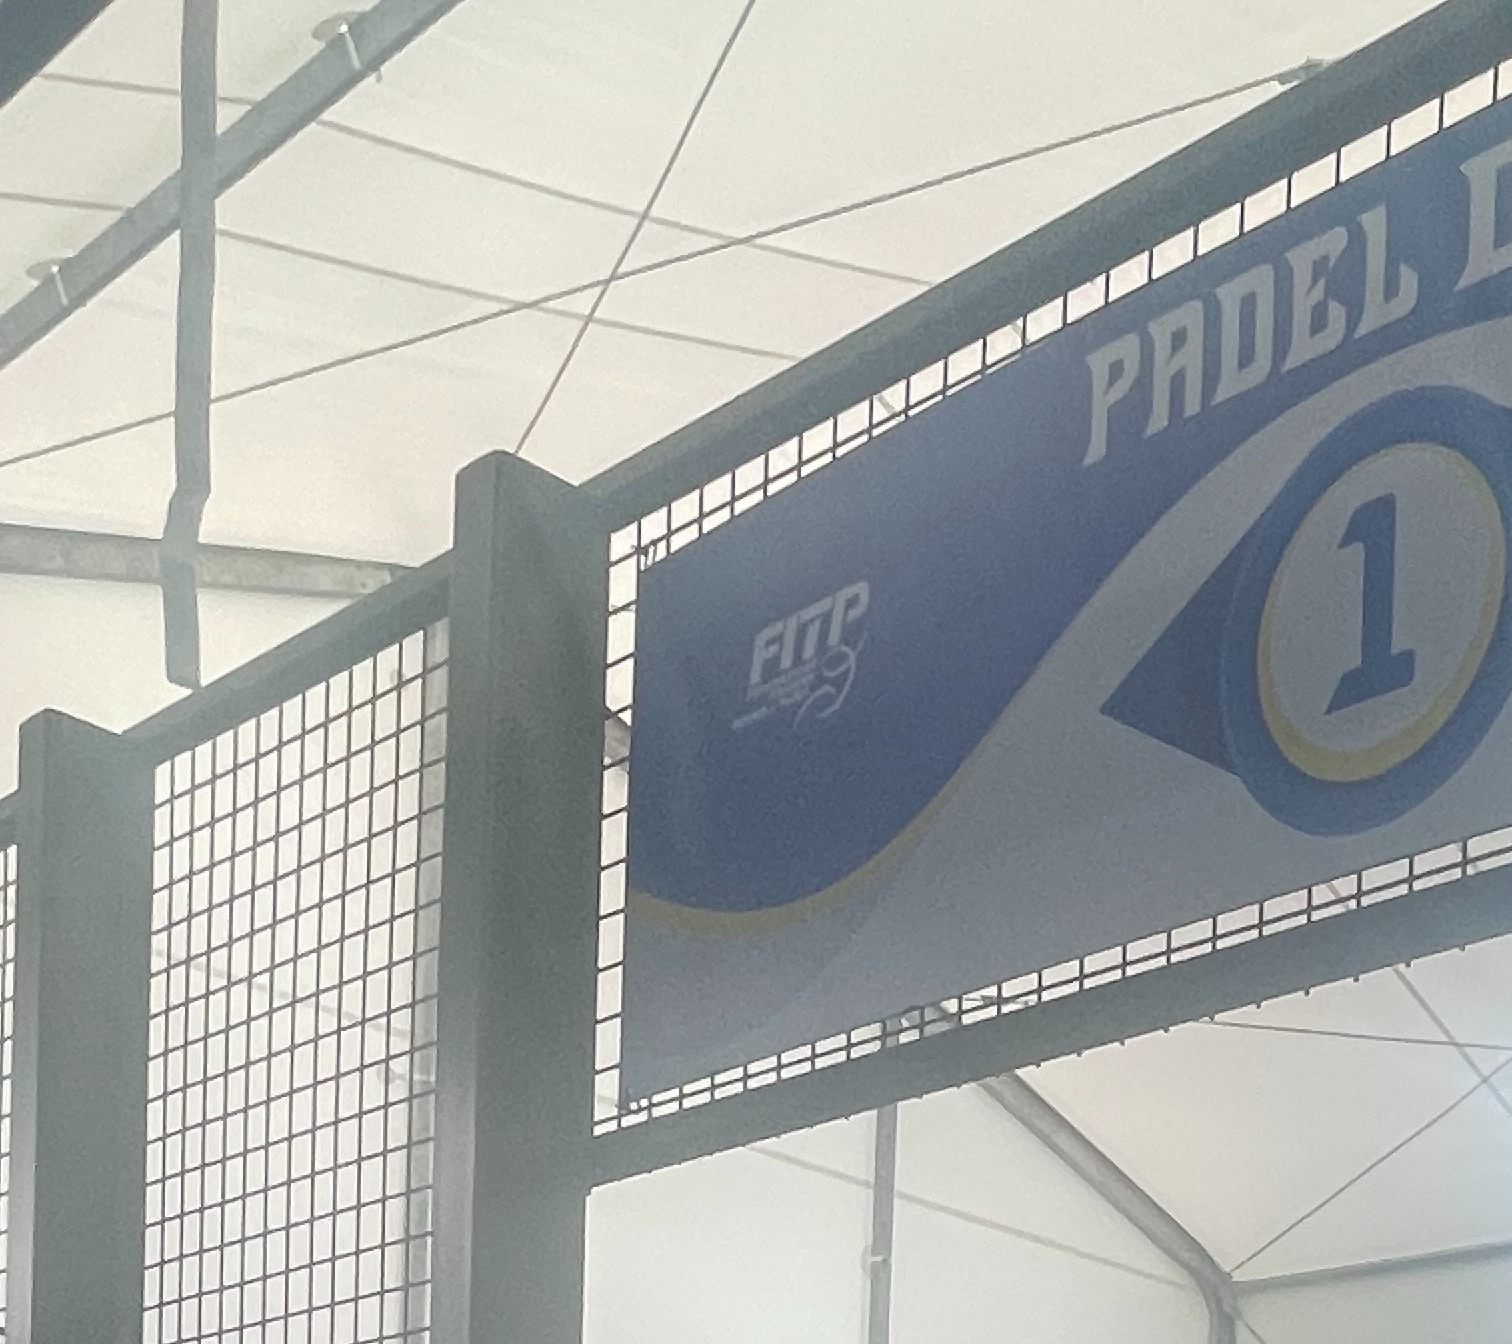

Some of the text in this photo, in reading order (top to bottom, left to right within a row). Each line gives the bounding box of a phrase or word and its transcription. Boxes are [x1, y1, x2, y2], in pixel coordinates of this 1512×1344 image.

[1083, 205, 1419, 468] PADEL
[750, 580, 870, 686] FITP
[1325, 491, 1416, 716] 1
